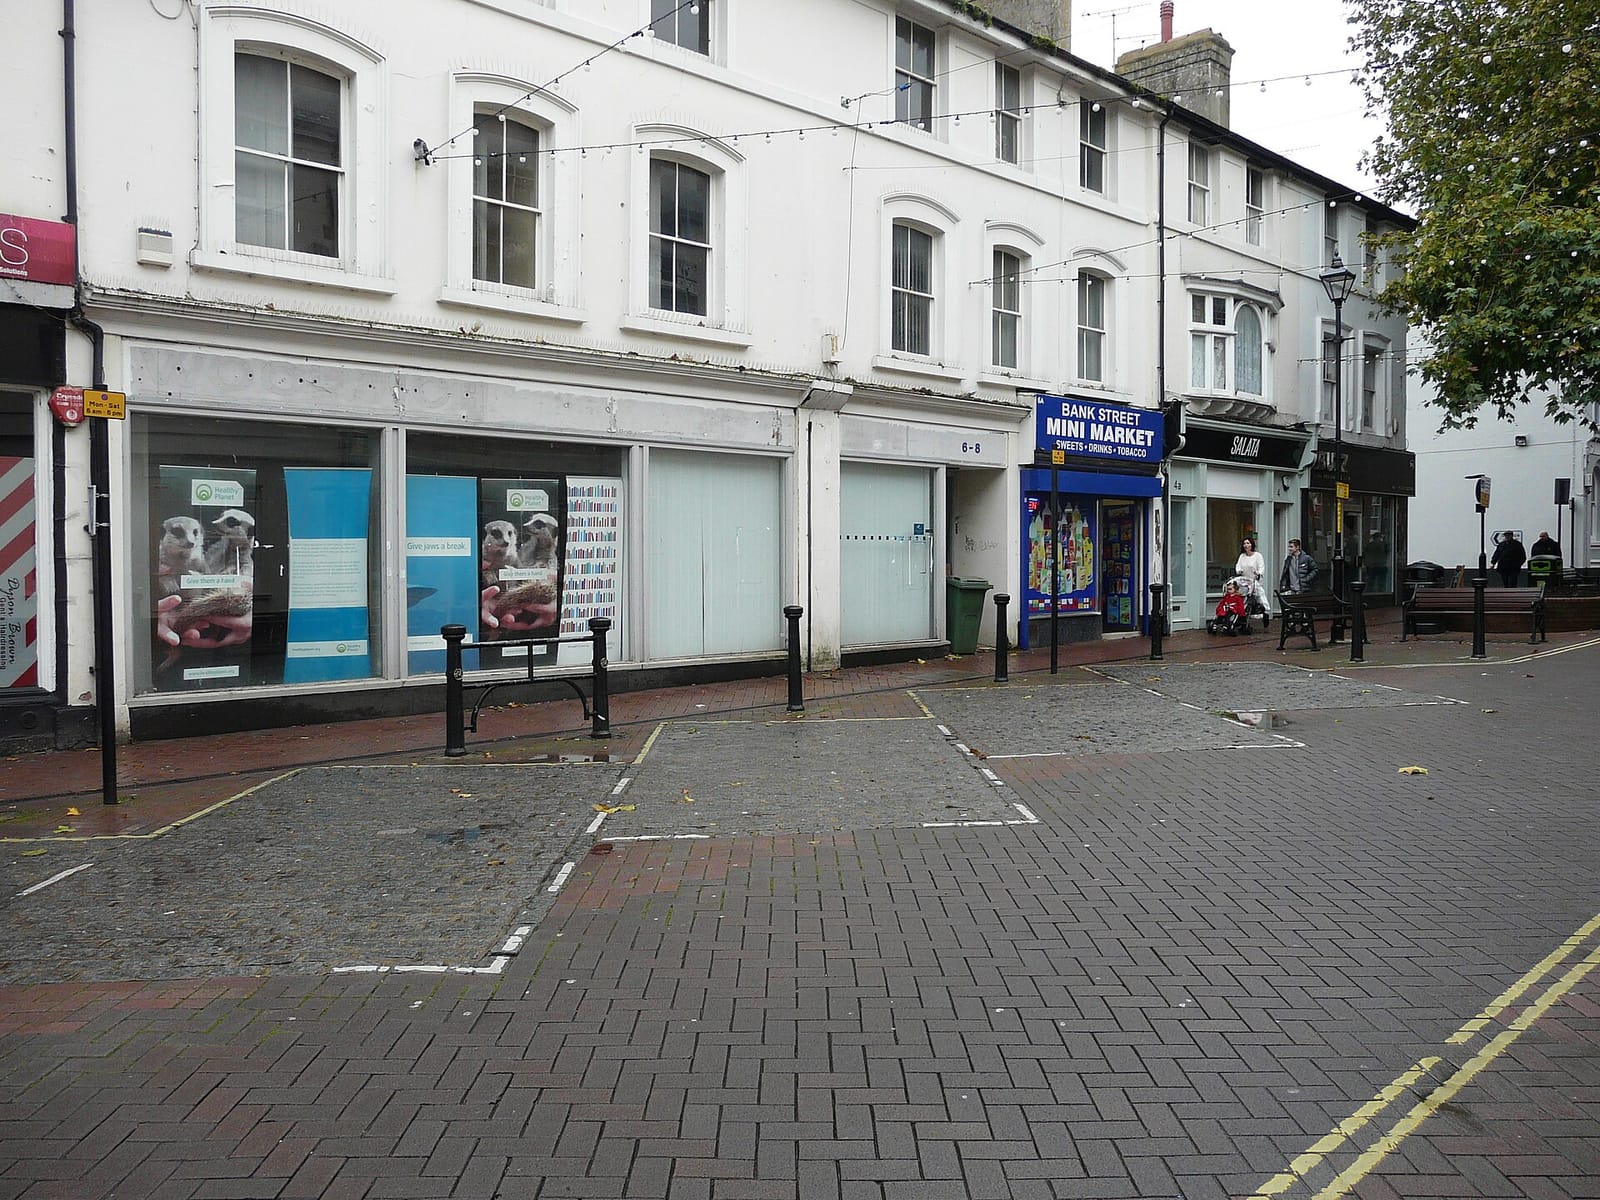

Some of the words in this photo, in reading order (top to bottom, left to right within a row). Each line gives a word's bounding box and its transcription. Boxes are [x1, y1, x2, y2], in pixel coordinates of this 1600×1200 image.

[89, 400, 103, 408] Mon
[1062, 402, 1096, 420] BANK
[1098, 408, 1141, 426] STREET
[1046, 417, 1085, 439] MINI
[1090, 423, 1155, 447] MARKET
[1056, 439, 1084, 452] SWEETS
[1088, 443, 1113, 455] DRINKS
[1117, 446, 1147, 458] TOBACCO
[1230, 435, 1261, 457] SALATA
[407, 542, 423, 550] Give
[423, 543, 440, 551] jaws
[1, 577, 20, 617] Dyson
[9, 622, 21, 664] Brown
